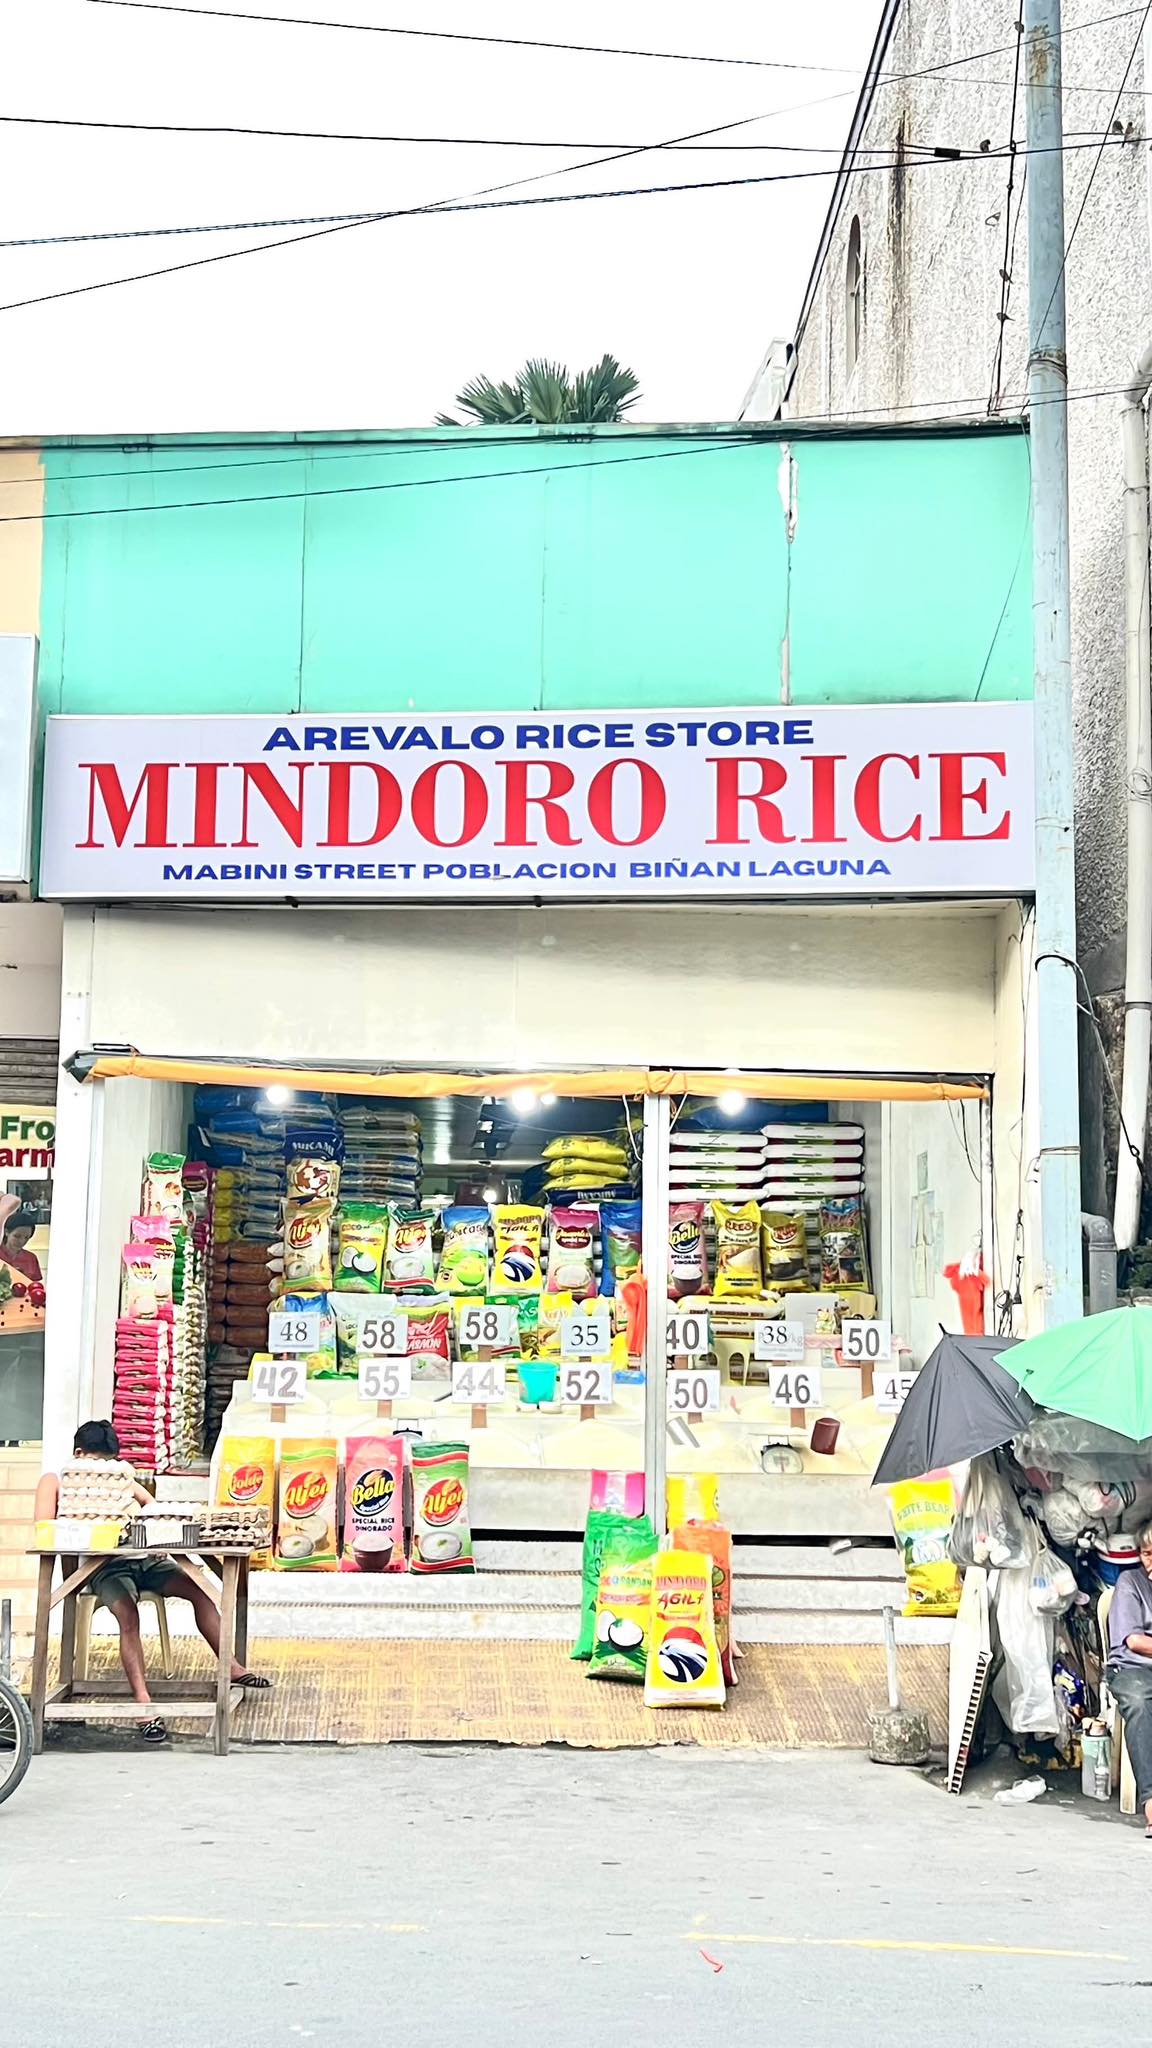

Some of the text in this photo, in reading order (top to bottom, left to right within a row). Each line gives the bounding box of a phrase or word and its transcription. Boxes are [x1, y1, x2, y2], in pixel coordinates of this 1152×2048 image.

[262, 719, 814, 751] AREVALO RICE STORE
[75, 752, 1011, 849] MINDORO RICE
[163, 857, 891, 880] MABINI STREET POBLACION BIÑAN LAGUNA
[280, 1321, 308, 1342] 48
[362, 1319, 396, 1349] 58
[465, 1311, 499, 1341] 58
[570, 1324, 599, 1346] 35
[666, 1319, 700, 1350] 40
[848, 1326, 881, 1358] 50
[256, 1366, 299, 1398] 42
[364, 1365, 400, 1397] 55
[456, 1366, 499, 1397] 44
[566, 1370, 600, 1401] 52
[673, 1378, 708, 1409] 50
[775, 1373, 811, 1404] 46
[352, 1475, 395, 1505] Bella
